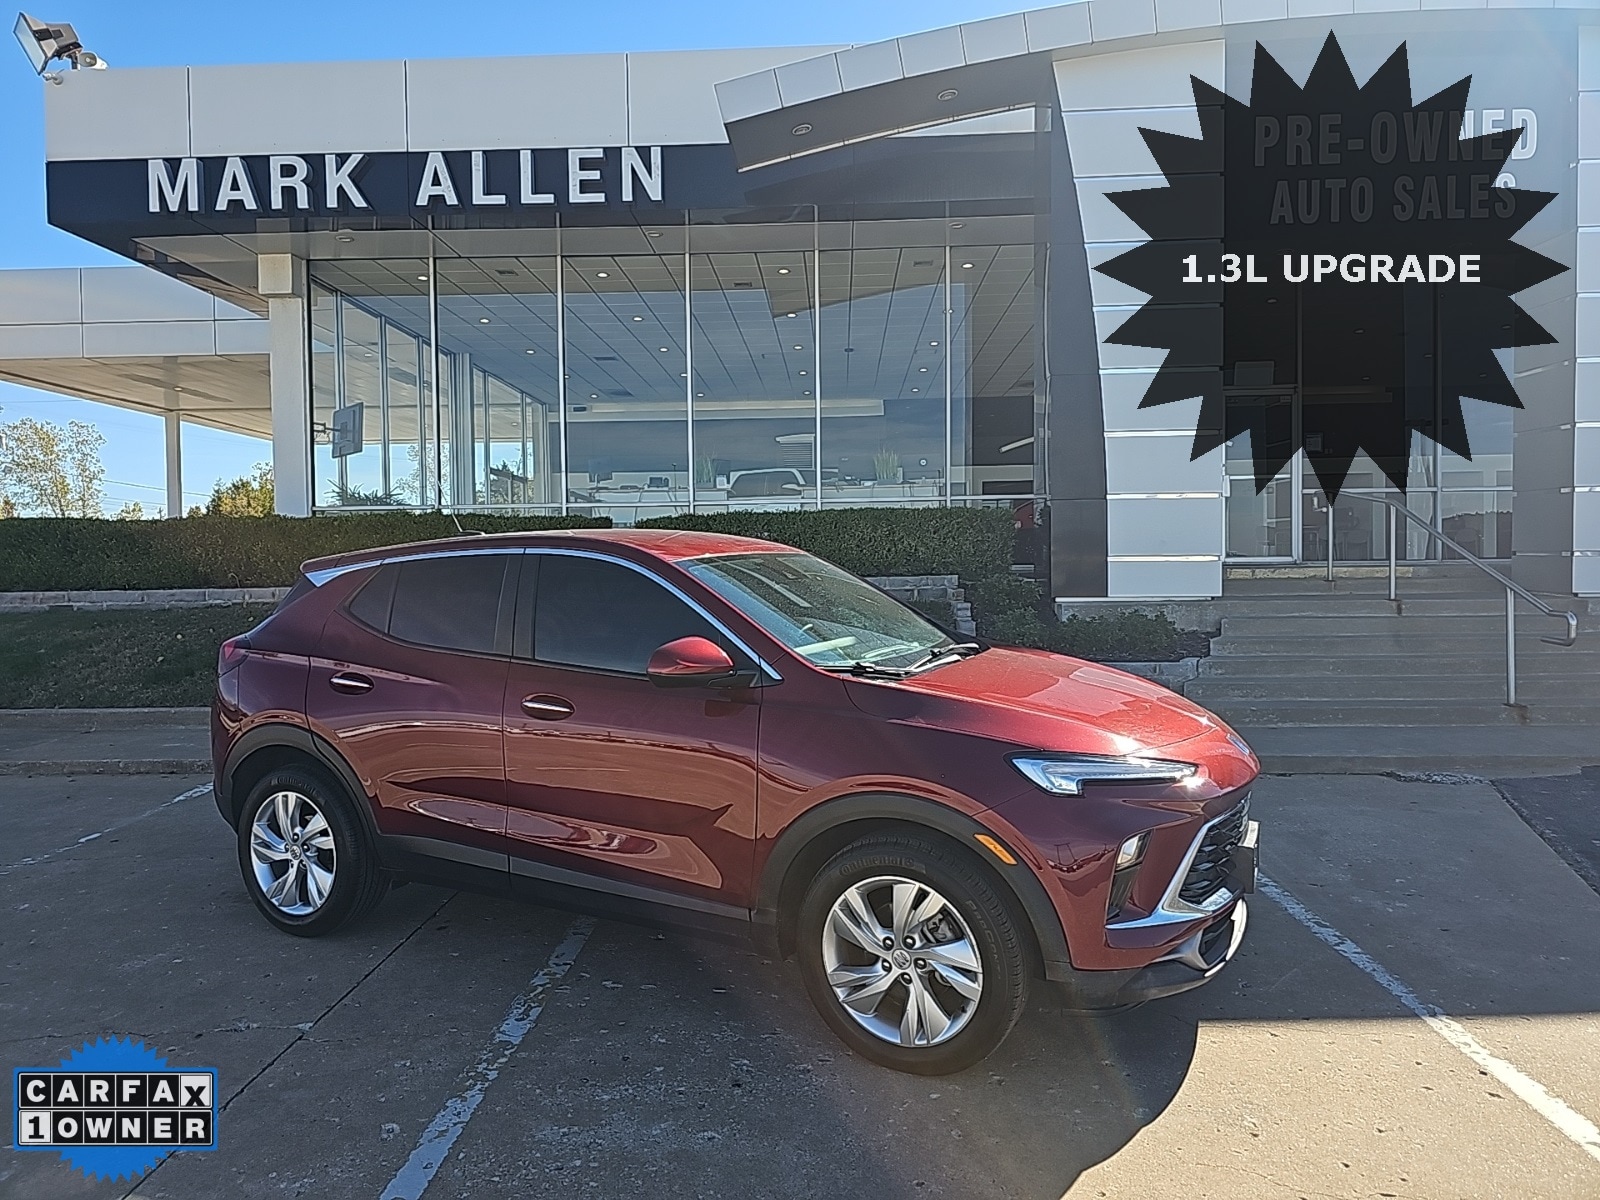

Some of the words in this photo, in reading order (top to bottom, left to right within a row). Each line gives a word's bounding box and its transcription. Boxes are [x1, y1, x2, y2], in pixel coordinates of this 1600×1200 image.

[1253, 108, 1538, 167] PRE-OWNED
[148, 153, 370, 212] MARK
[415, 146, 663, 206] ALLEN
[1269, 177, 1375, 225] AUTO
[1393, 172, 1518, 222] SALES
